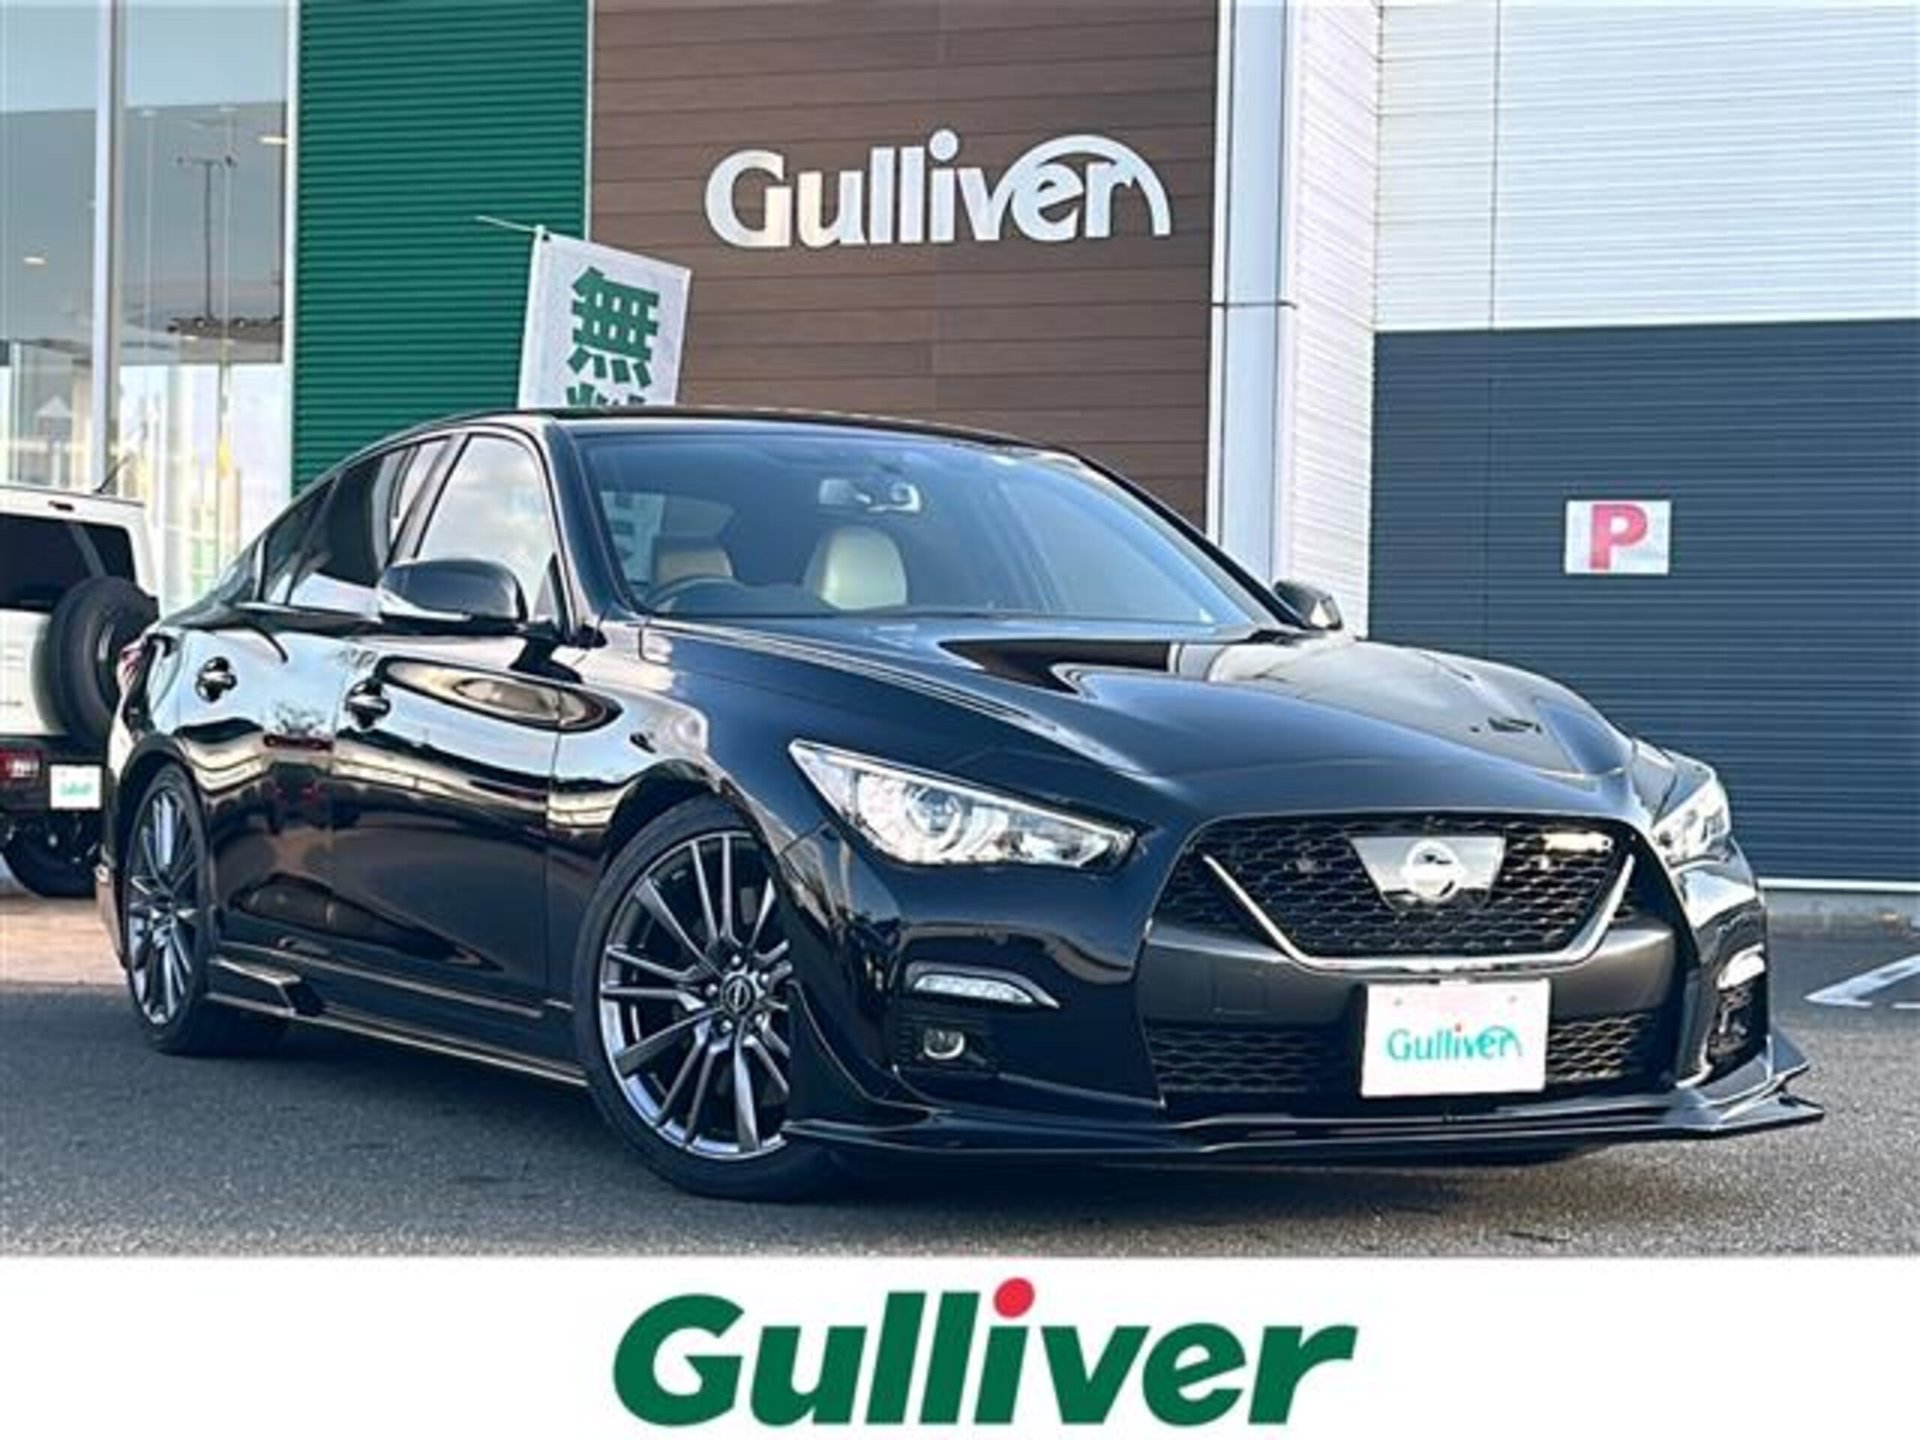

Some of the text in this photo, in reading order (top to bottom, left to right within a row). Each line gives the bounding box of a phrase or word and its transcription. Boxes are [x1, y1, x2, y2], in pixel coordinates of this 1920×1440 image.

[705, 129, 1172, 249] Gulliver
[566, 266, 660, 405] 無
[1590, 503, 1648, 570] P
[1387, 1023, 1523, 1062] Gulliver
